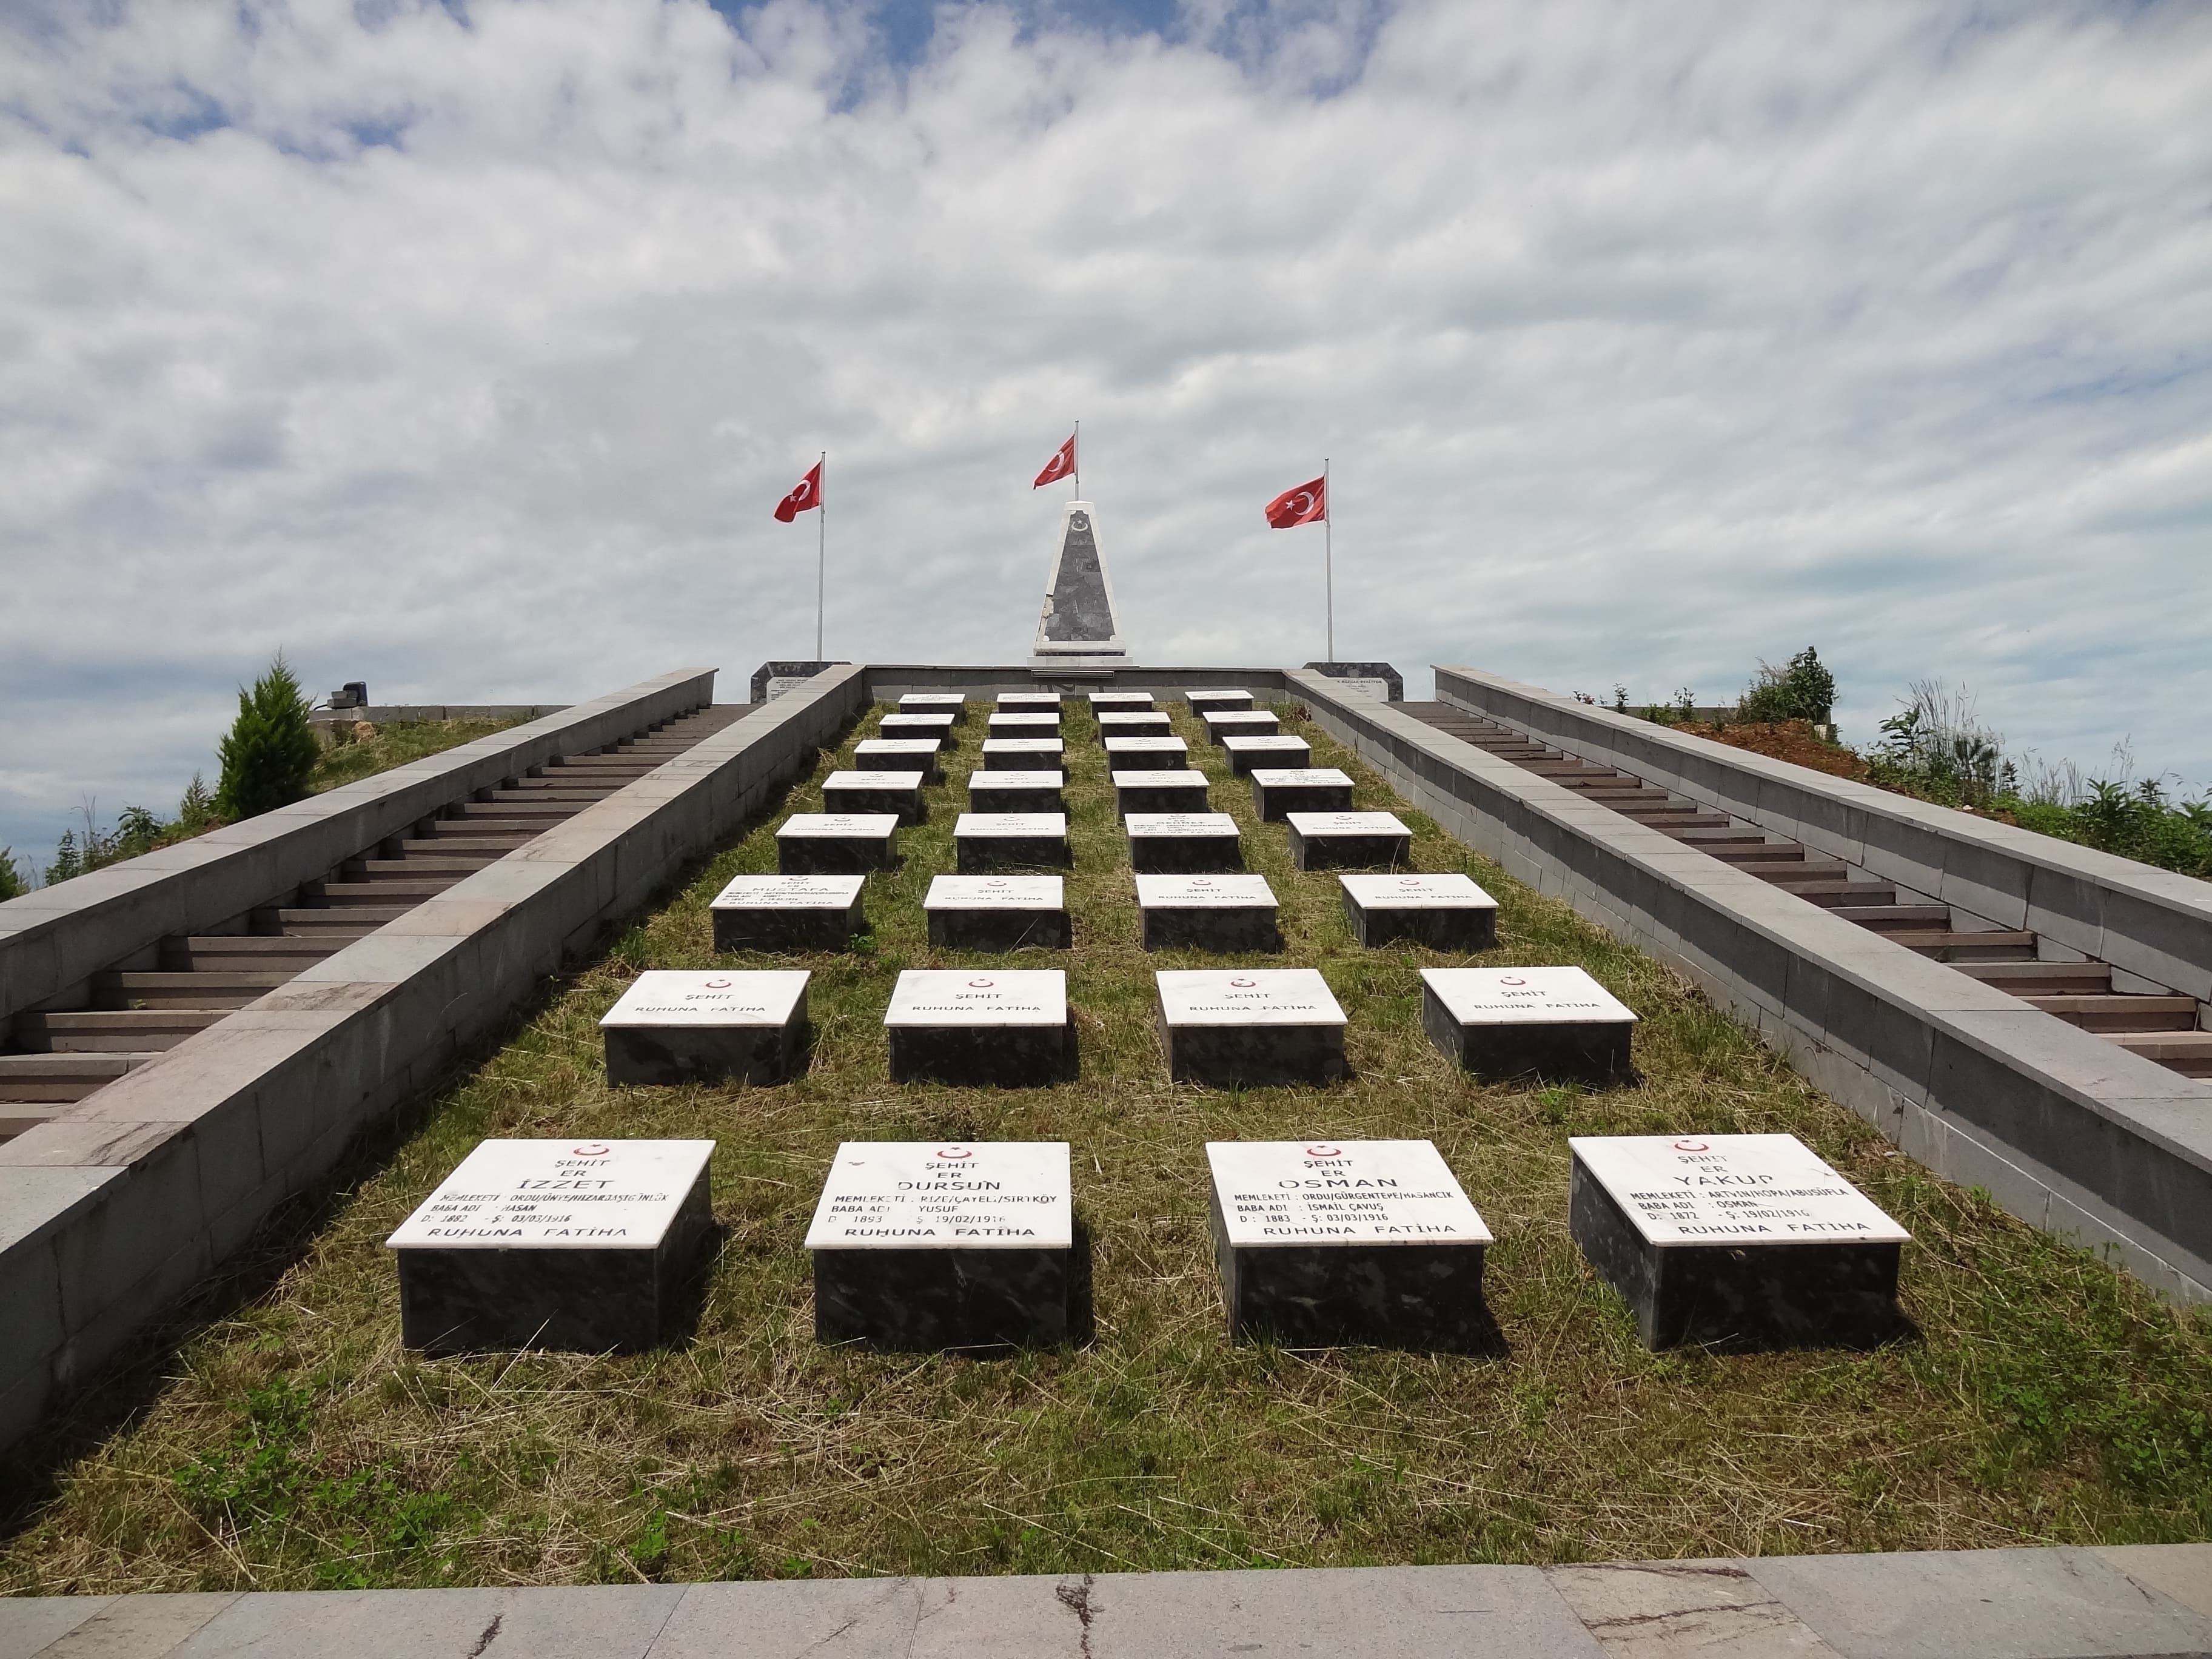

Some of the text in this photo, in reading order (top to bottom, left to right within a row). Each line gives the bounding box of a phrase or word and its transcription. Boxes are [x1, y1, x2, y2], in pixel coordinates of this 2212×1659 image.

[555, 1159, 611, 1168] ŞEHİT
[926, 1161, 980, 1170] ŞEHİT
[1304, 1159, 1354, 1168] ŞEHİT
[517, 1179, 615, 1188] İZZET
[1279, 1179, 1398, 1188] OSMAN
[1674, 1175, 1774, 1185] YAKUP
[899, 1181, 1000, 1190] DURSUN
[1235, 1193, 1291, 1201] MEMLEKETİ
[1631, 1190, 1697, 1199] MEMLEKETİ
[1308, 1202, 1346, 1211] İSMAİL
[1350, 1203, 1384, 1212] ÇAVUŞ
[1327, 1213, 1389, 1222] 03/03/1916
[428, 1227, 626, 1238] RUHUNA FATİHA
[956, 1227, 1036, 1236] FATİHA
[1375, 1224, 1457, 1233] FATİHA
[1678, 1222, 1872, 1234] RUHUNA FATİHA
